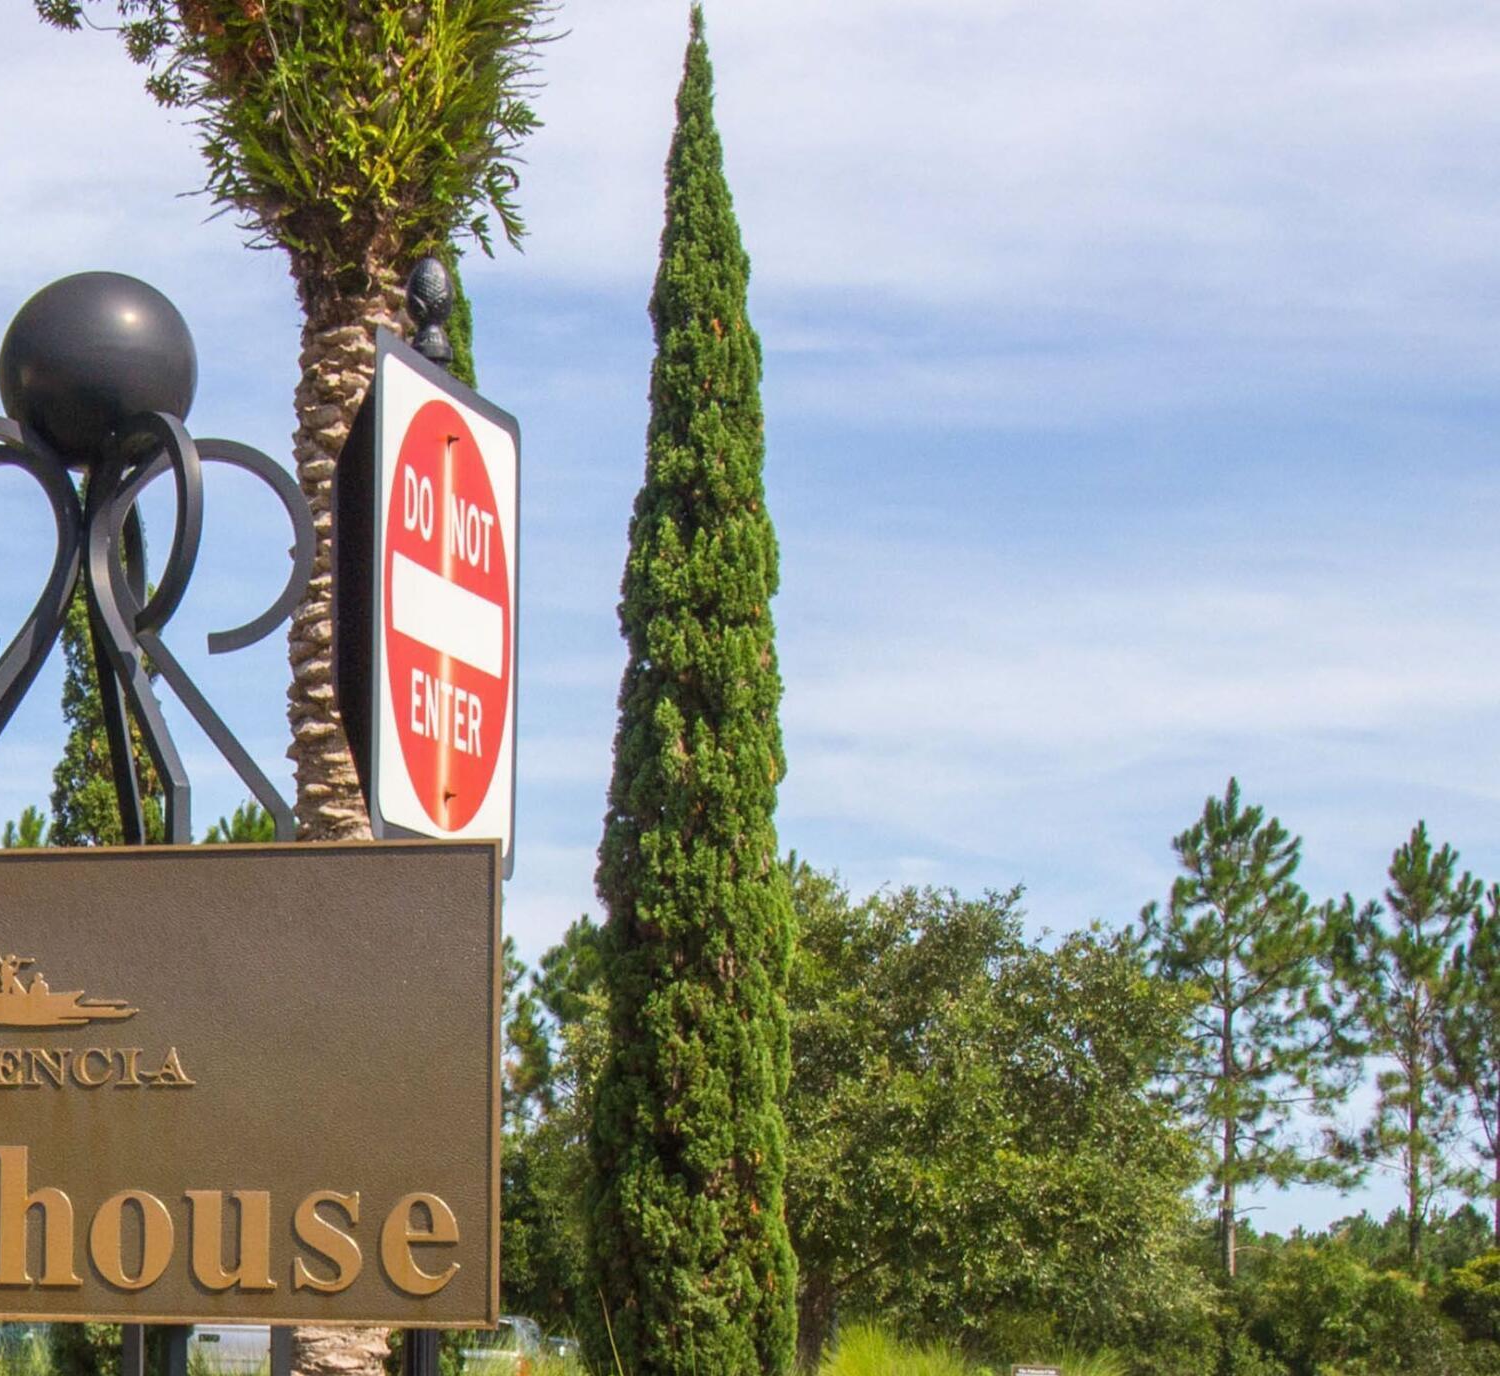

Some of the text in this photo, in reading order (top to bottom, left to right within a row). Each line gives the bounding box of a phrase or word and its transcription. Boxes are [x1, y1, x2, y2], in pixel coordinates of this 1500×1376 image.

[403, 463, 495, 575] DO NOT
[410, 667, 483, 758] ENTER
